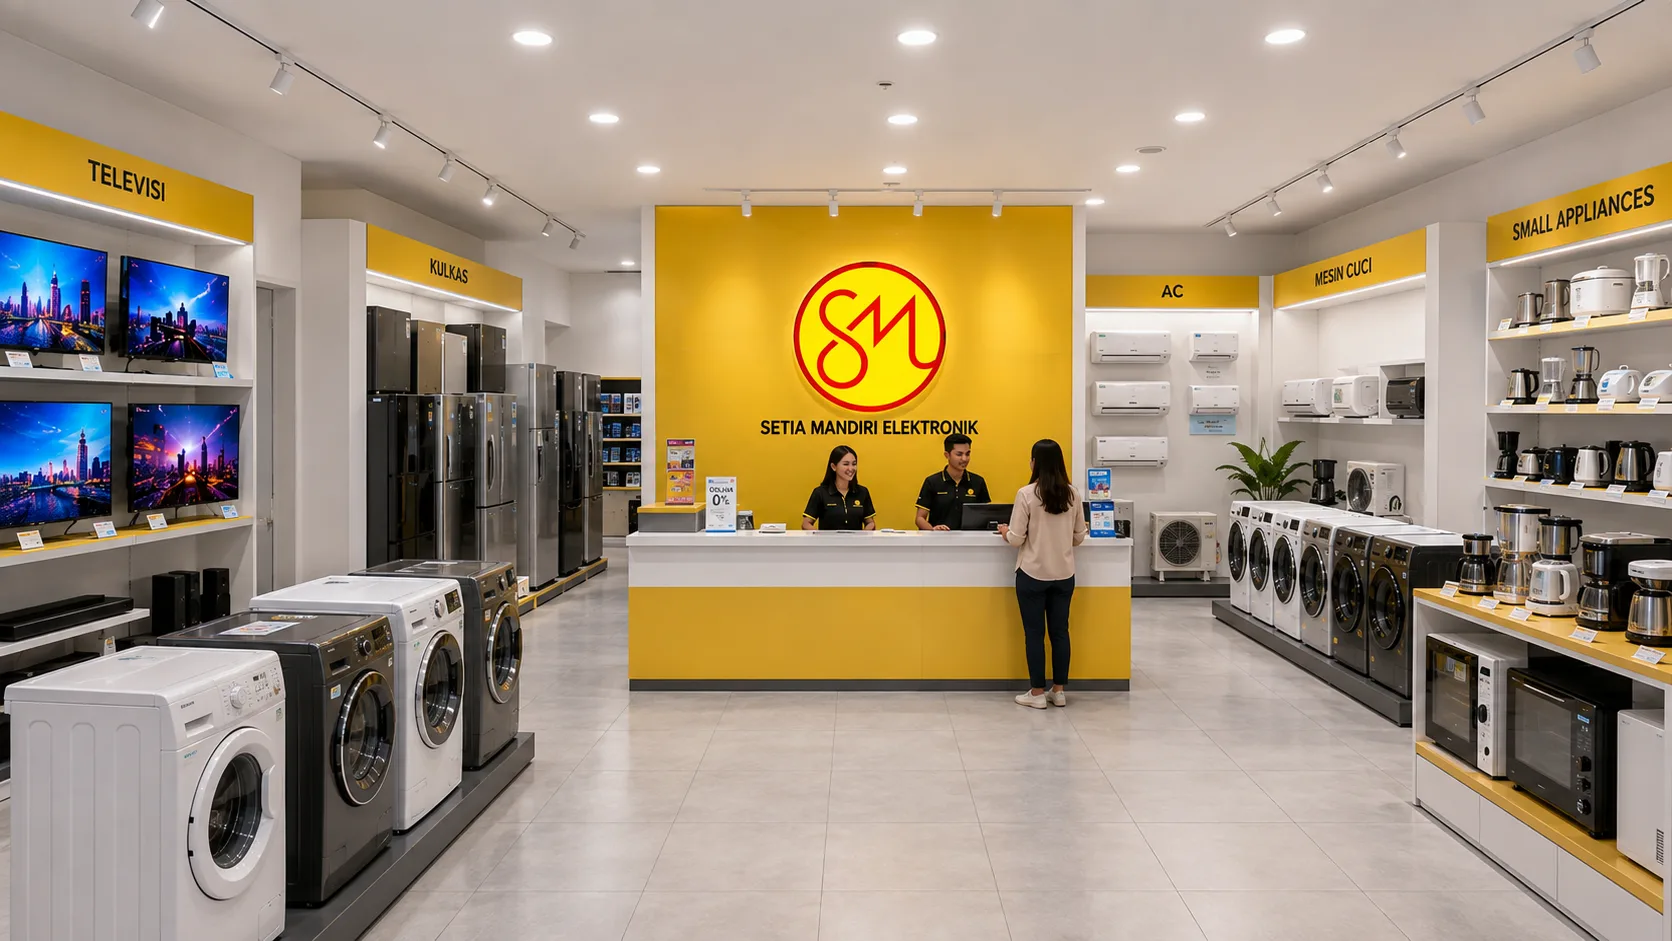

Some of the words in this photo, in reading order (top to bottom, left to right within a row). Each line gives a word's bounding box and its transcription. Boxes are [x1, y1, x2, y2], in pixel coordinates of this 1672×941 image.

[87, 159, 165, 202] TELEVISI
[1512, 213, 1553, 241] SMALL
[1556, 184, 1655, 230] APPLIANCES
[430, 258, 468, 284] KULKAS
[1315, 262, 1344, 287] MESIN
[1346, 257, 1372, 279] CUCI
[1161, 284, 1184, 298] AC
[817, 288, 937, 390] SM
[760, 419, 807, 435] SETIA
[810, 420, 878, 435] MANDIRI
[882, 420, 979, 435] ELEKTRONIK
